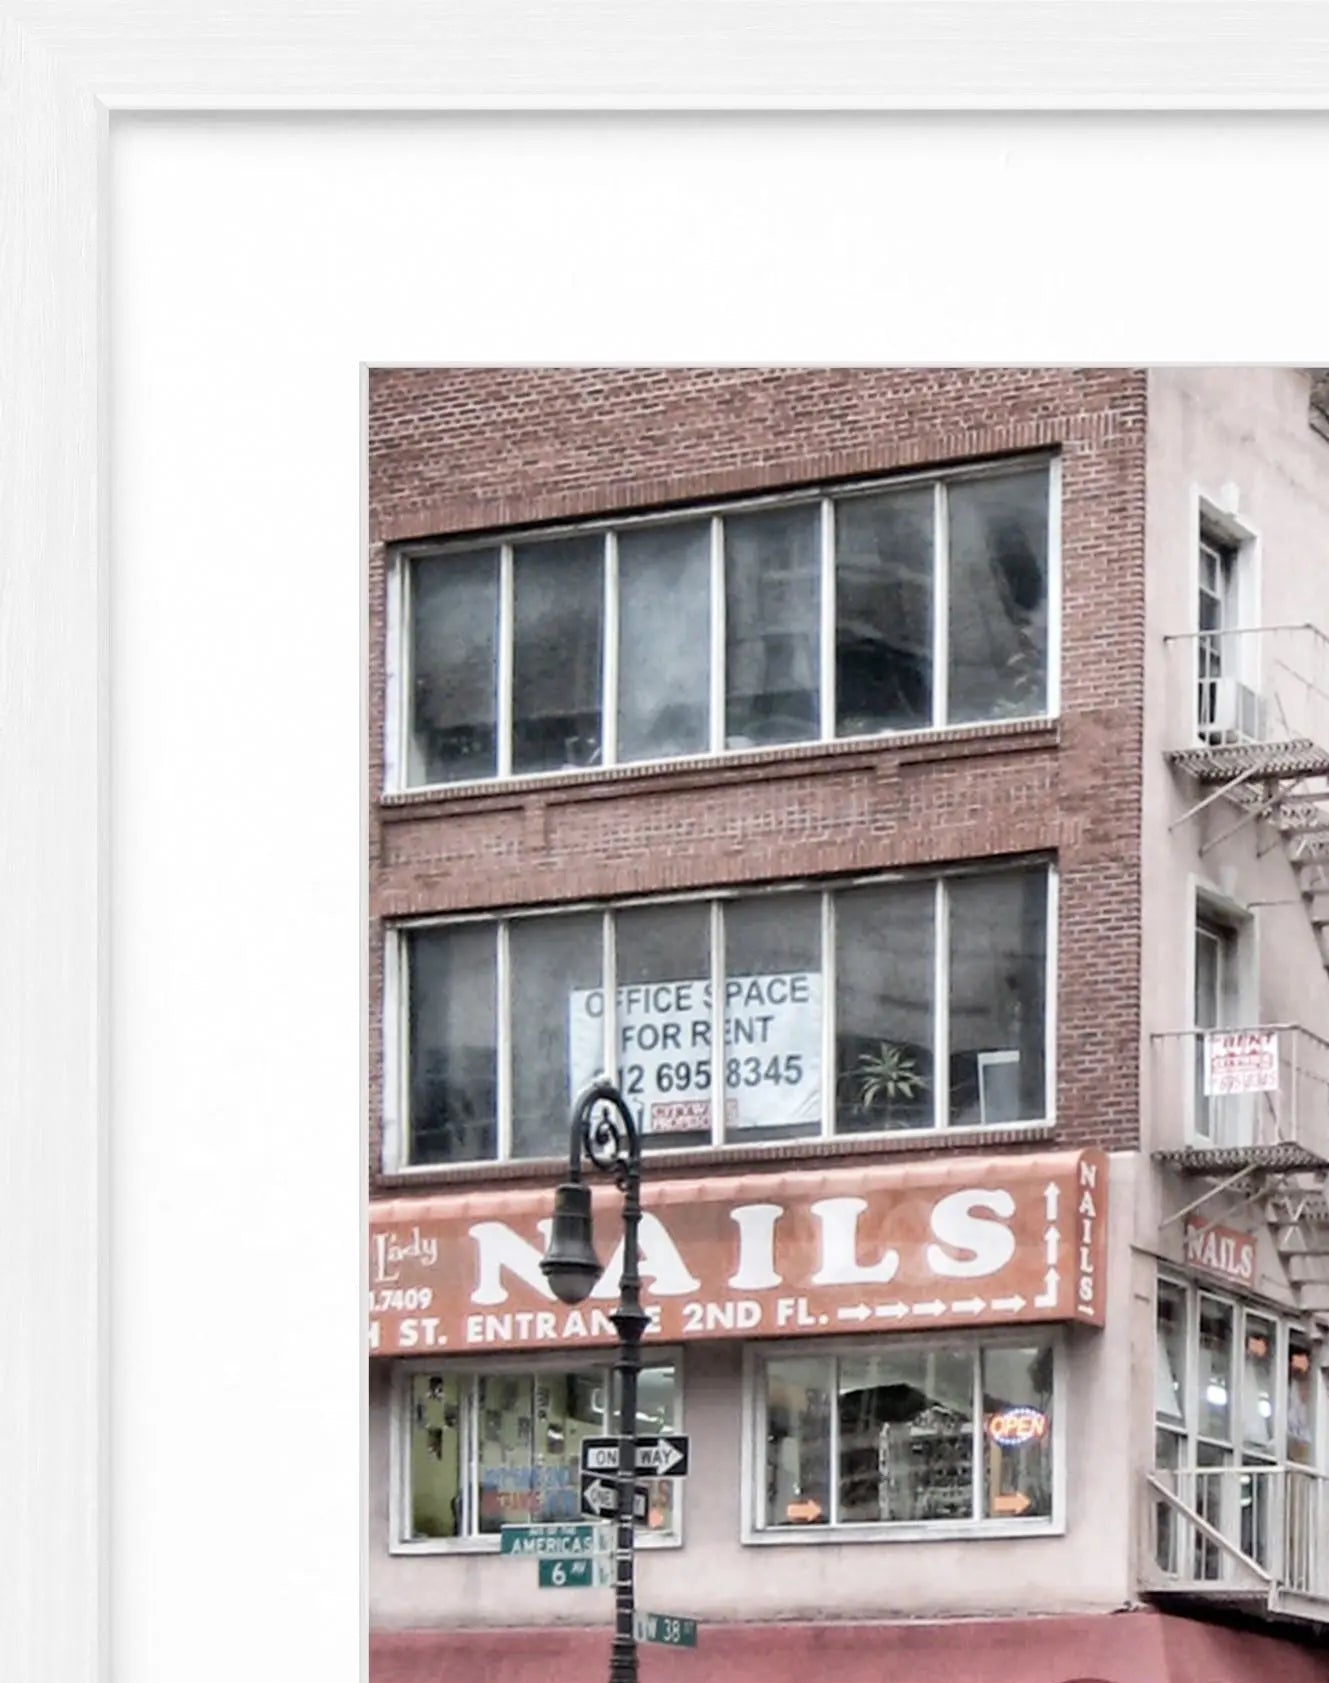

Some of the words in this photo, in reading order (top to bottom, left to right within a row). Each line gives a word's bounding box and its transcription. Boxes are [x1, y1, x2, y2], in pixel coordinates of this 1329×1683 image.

[703, 975, 809, 1007] SPACE
[621, 1022, 682, 1053] FOR
[655, 1059, 712, 1094] 695
[726, 1054, 804, 1089] 8345
[468, 1187, 1016, 1306] NAILS
[1079, 1161, 1097, 1302] NAILS
[1187, 1223, 1254, 1279] NAILS
[399, 1317, 448, 1347] ST.
[467, 1306, 662, 1343] ENTRANE
[682, 1300, 762, 1332] 2ND
[776, 1297, 829, 1327] FL.
[990, 1414, 1045, 1440] OPEN
[595, 1450, 618, 1465] ON
[641, 1449, 673, 1465] WAY
[511, 1536, 593, 1554] AMERICAS
[552, 1561, 567, 1586] 6
[663, 1618, 681, 1642] 38
